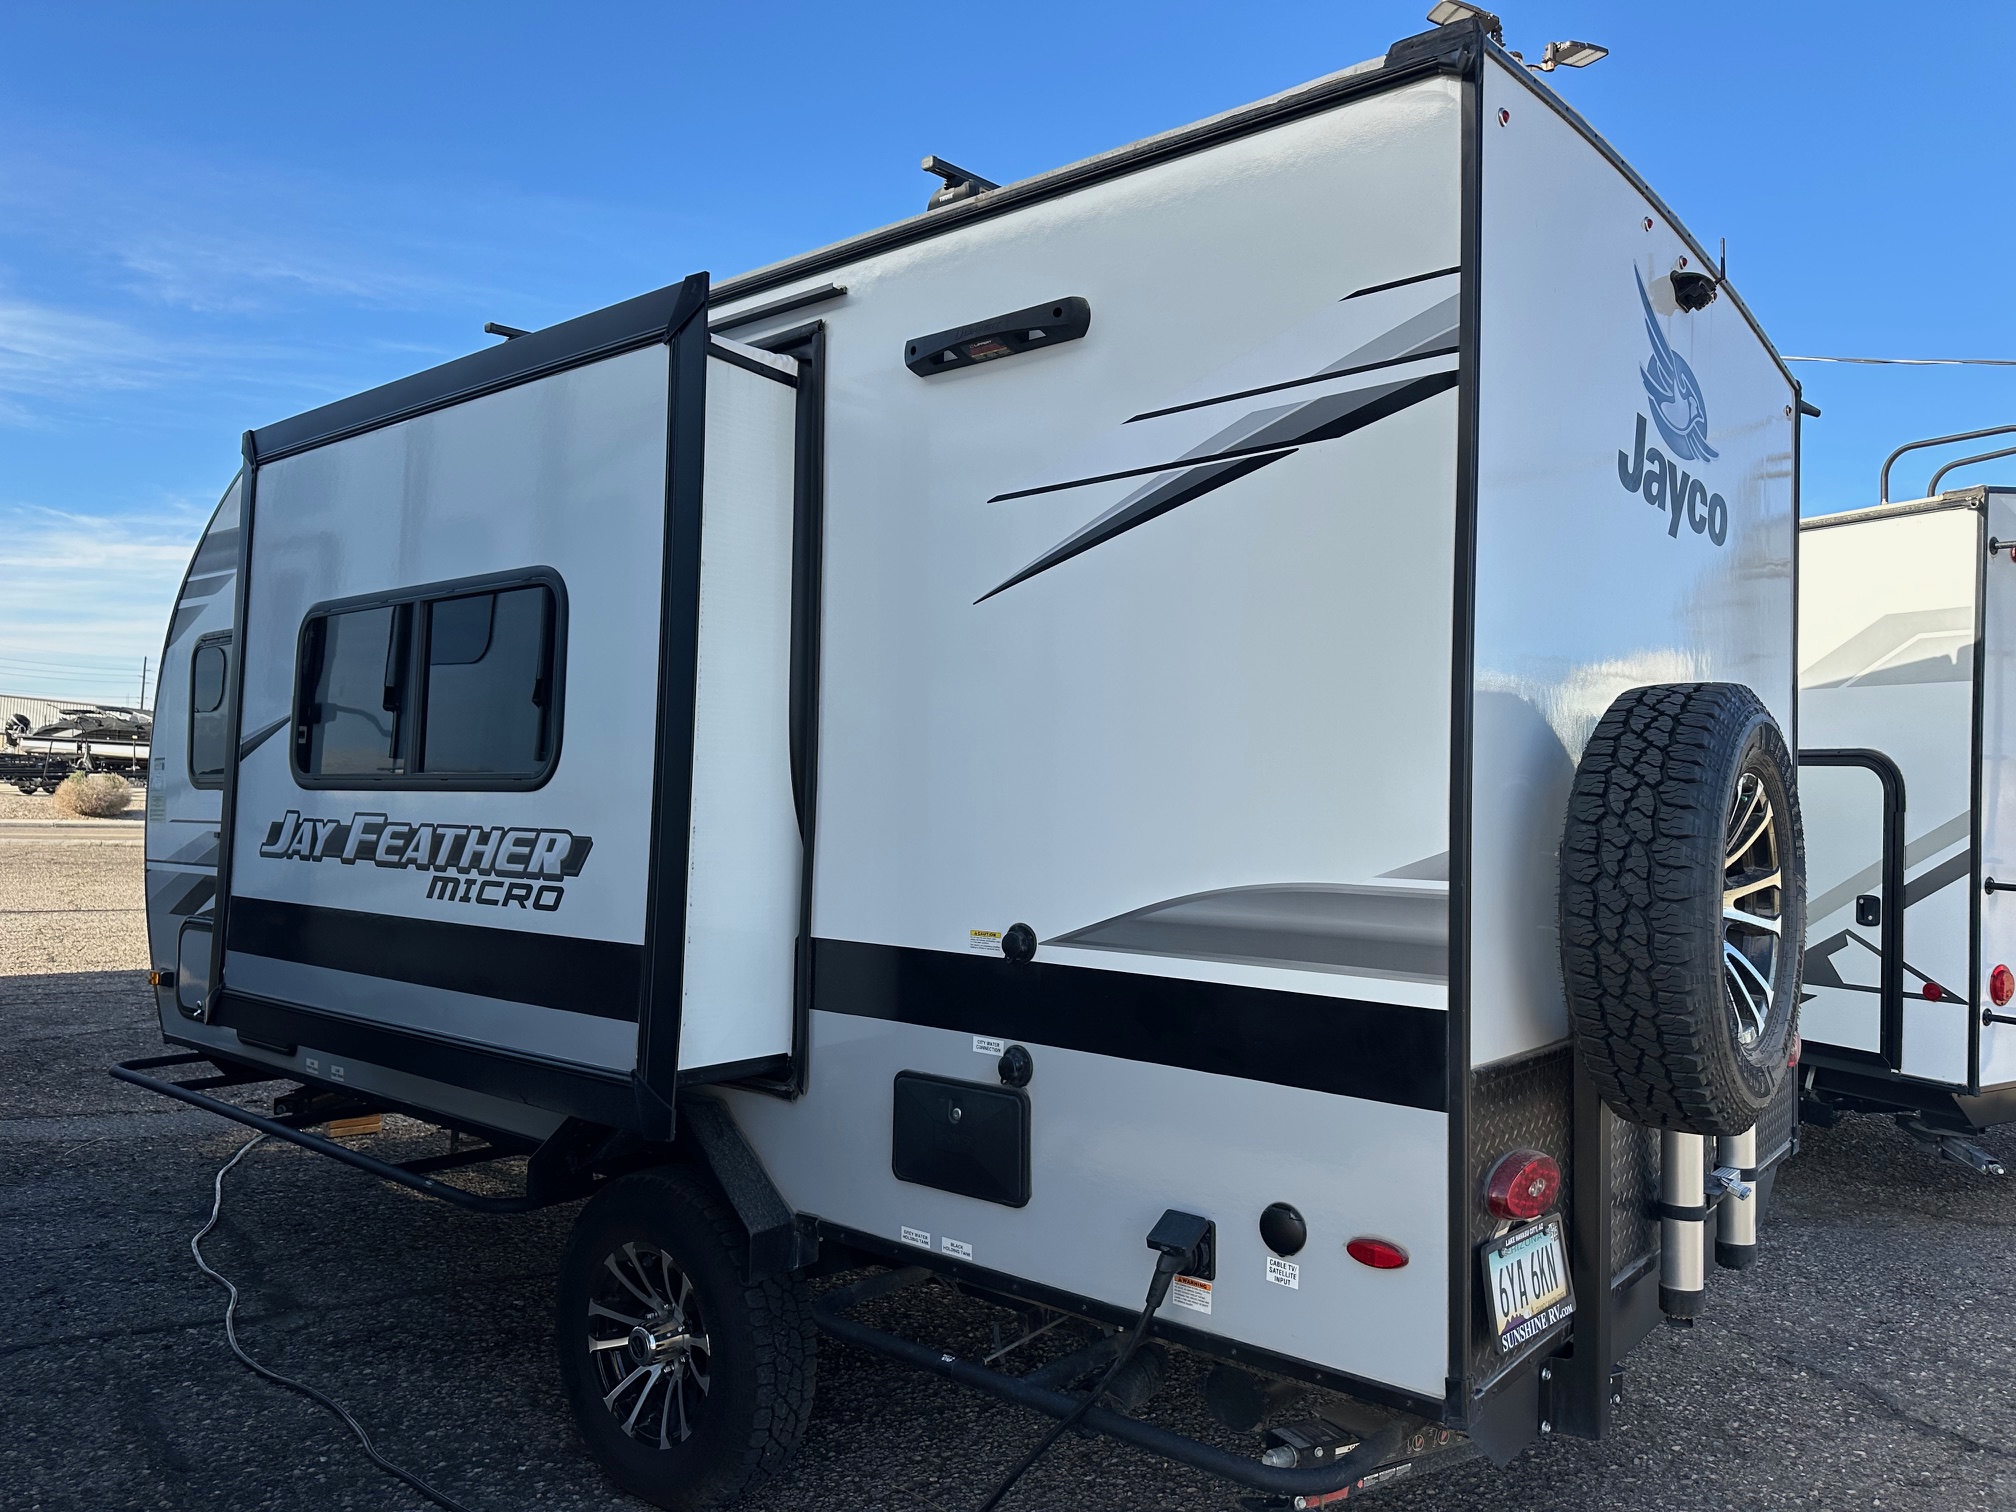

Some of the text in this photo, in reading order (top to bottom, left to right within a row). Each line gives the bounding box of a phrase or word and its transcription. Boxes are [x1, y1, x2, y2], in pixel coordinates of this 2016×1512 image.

[1618, 412, 1728, 547] Jayco
[259, 809, 573, 882] JAY FEATHER
[426, 874, 565, 912] MICRO
[976, 1045, 1001, 1053] CONNECTION
[903, 1235, 919, 1243] HOLDING
[1505, 1234, 1516, 1247] LAKE
[943, 1246, 960, 1255] HOLDING
[1269, 1259, 1287, 1270] CABLE
[1269, 1266, 1297, 1280] SATELLITE
[1182, 1278, 1207, 1289] WARNING
[1274, 1276, 1291, 1286] INPUT
[1499, 1243, 1559, 1318] 6YA 6KN
[1501, 1312, 1549, 1353] SUNSHINE
